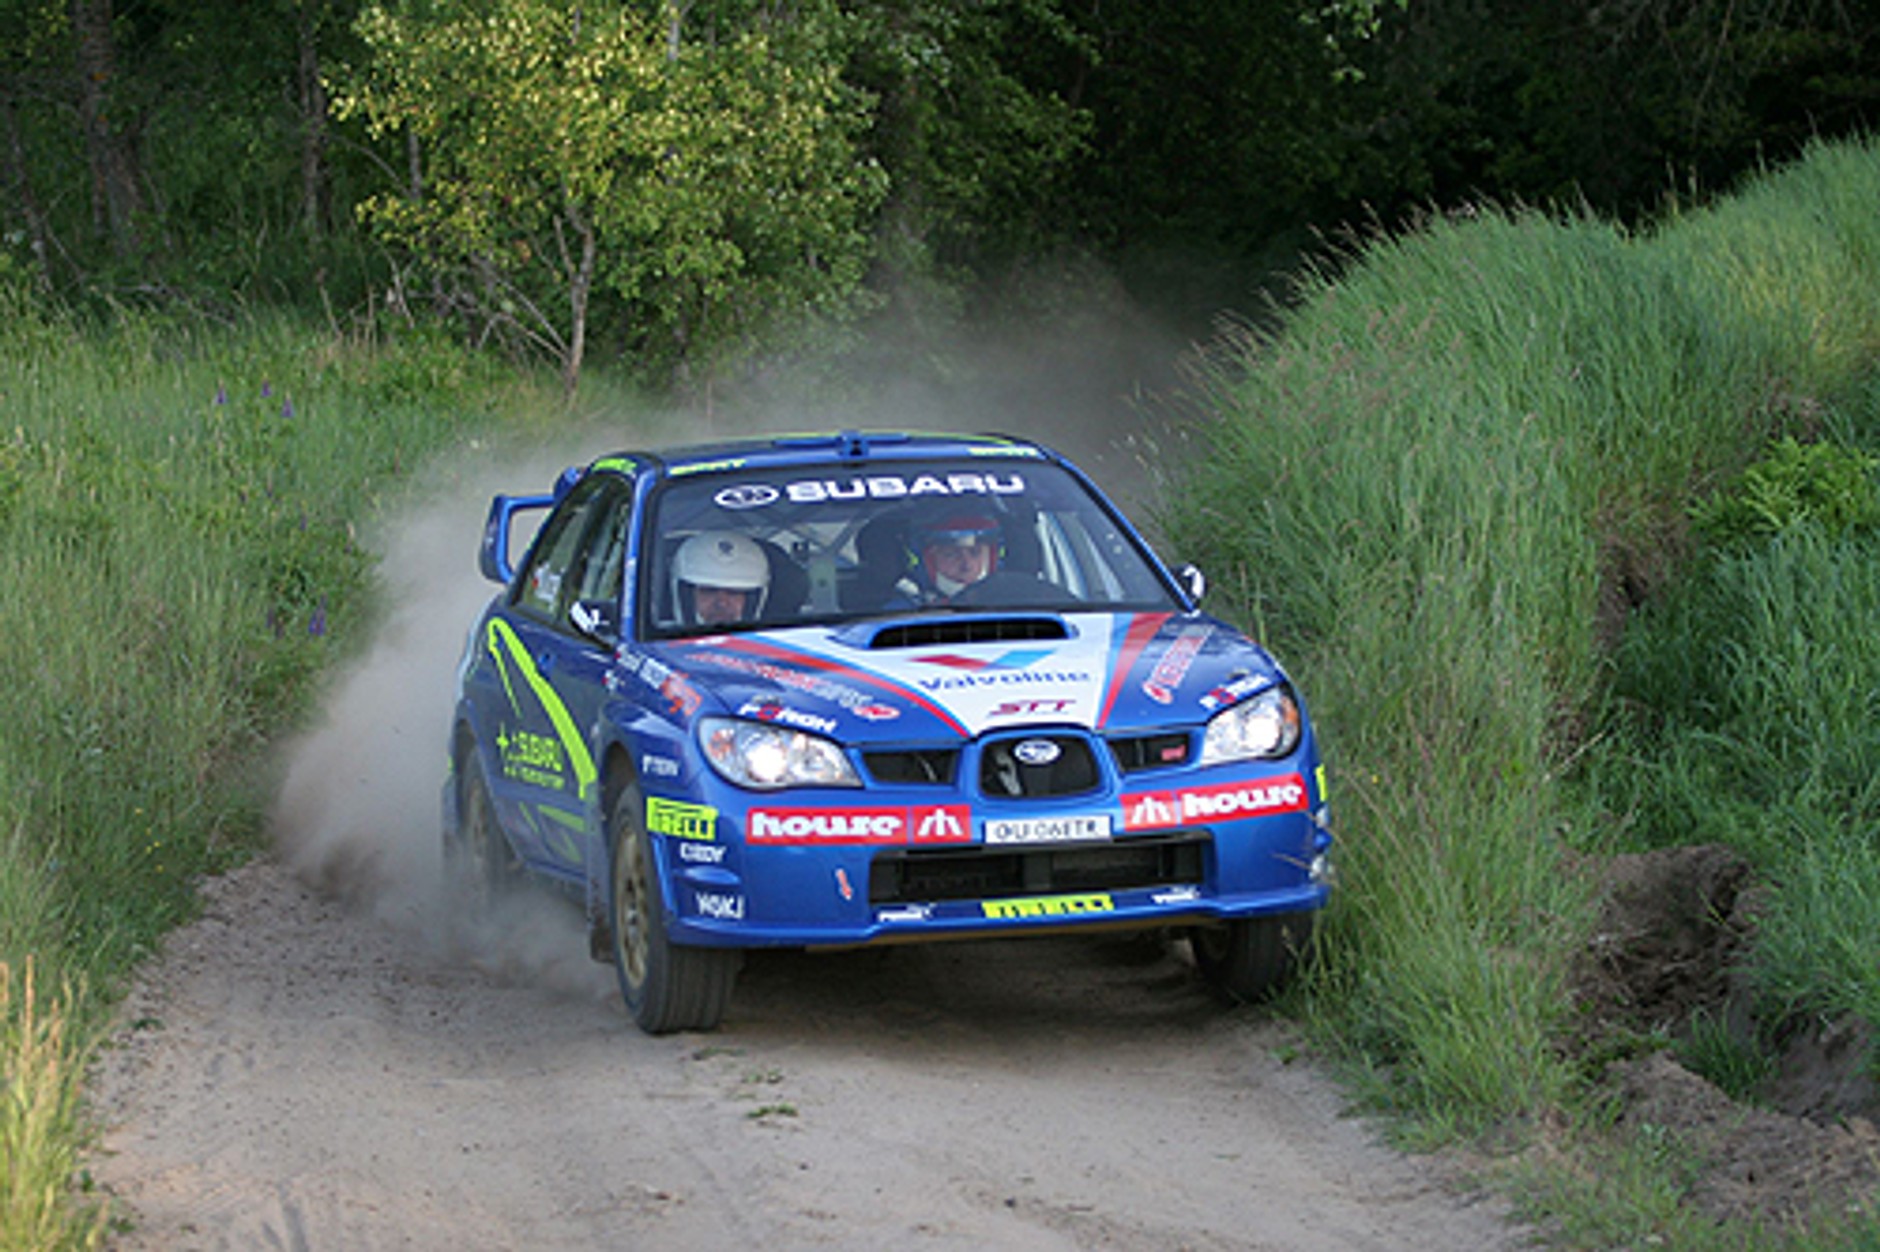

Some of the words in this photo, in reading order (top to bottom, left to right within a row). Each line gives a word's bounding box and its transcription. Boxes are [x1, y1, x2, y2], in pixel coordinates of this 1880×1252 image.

[786, 473, 1025, 502] SUBARU
[918, 671, 1089, 690] Valvoline
[752, 812, 902, 836] house
